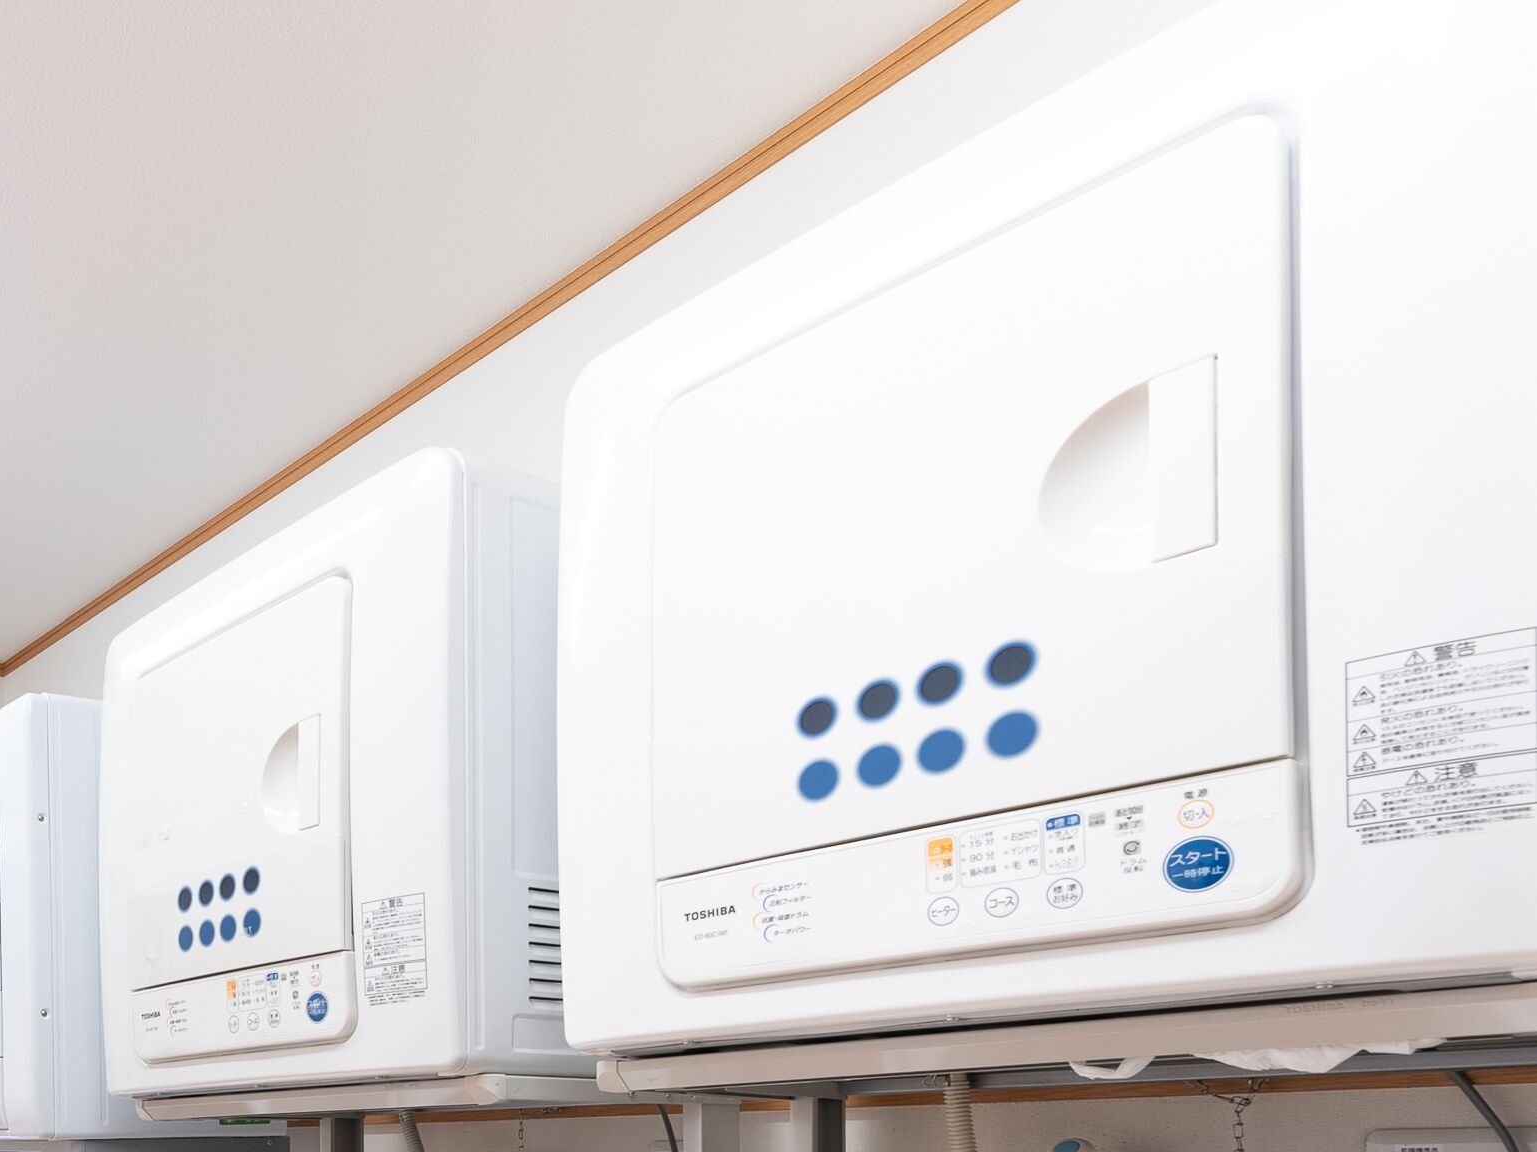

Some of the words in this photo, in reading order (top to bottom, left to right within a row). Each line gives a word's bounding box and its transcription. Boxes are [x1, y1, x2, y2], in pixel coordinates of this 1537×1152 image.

[1433, 641, 1477, 661] 警告
[1434, 762, 1478, 782] 注意
[1169, 848, 1228, 867] スタート
[1171, 865, 1224, 879] 一時停止
[988, 896, 1015, 909] コース
[684, 905, 736, 922] TOSHIBA
